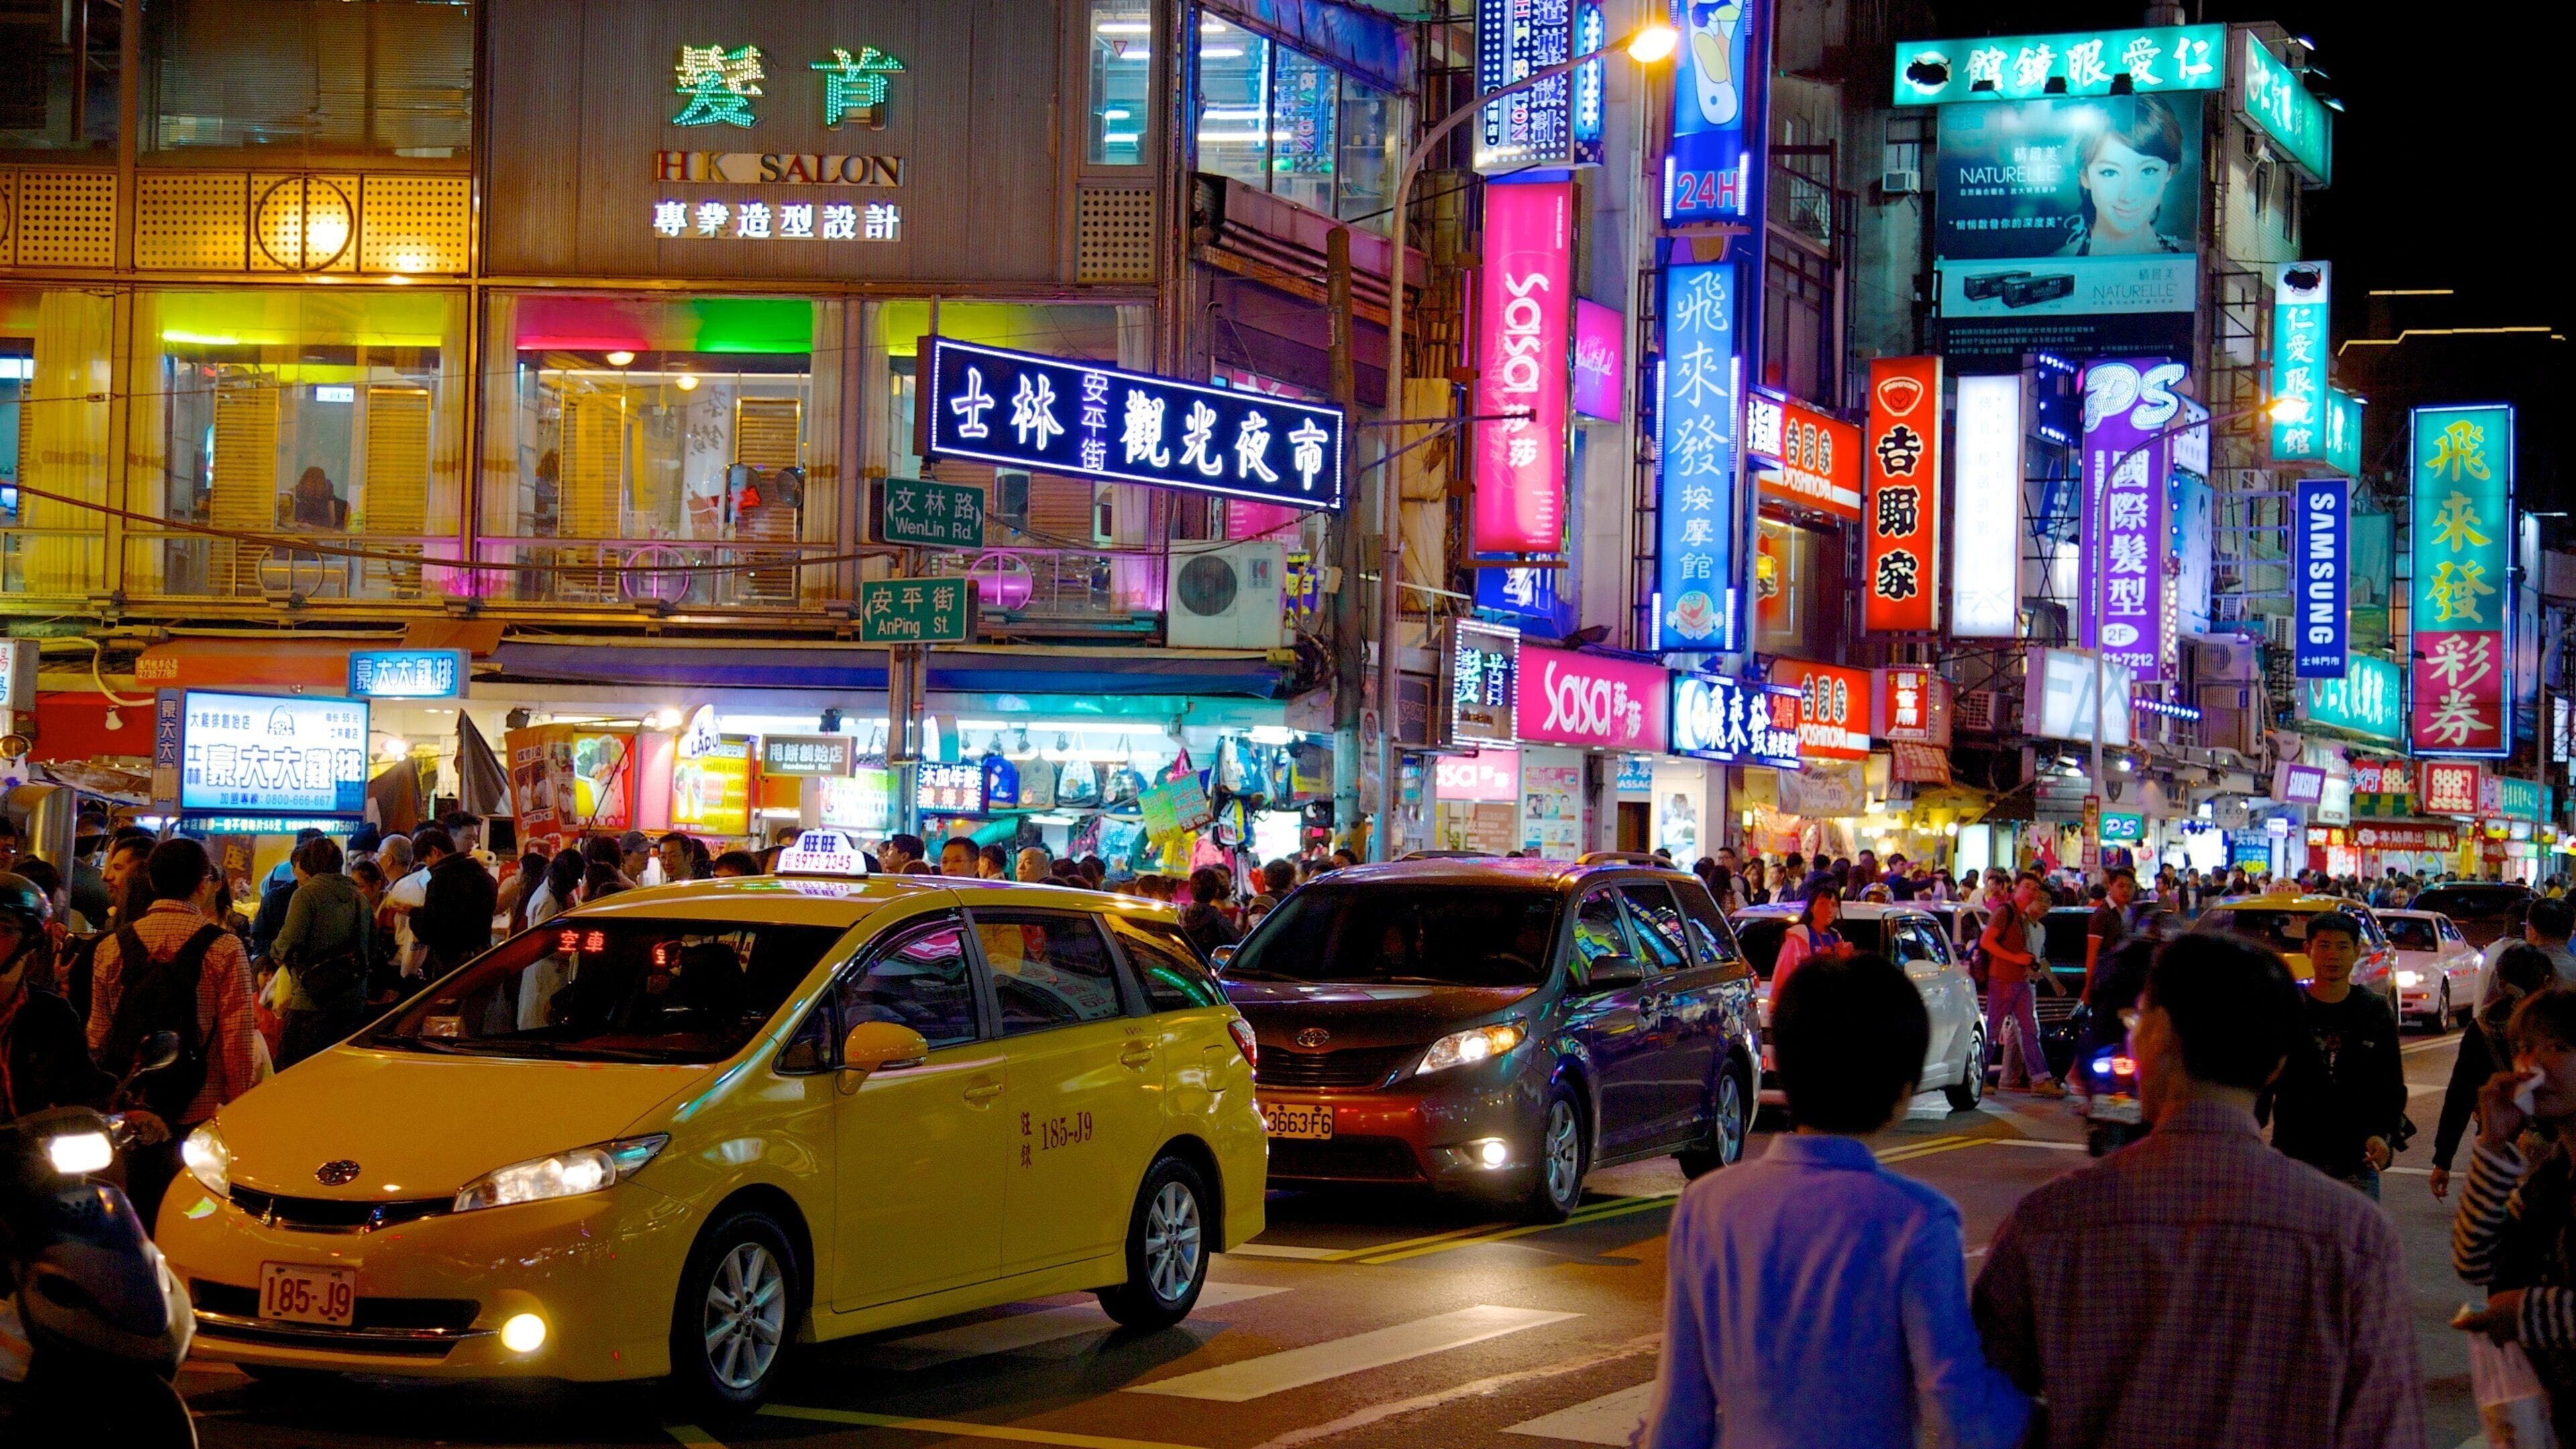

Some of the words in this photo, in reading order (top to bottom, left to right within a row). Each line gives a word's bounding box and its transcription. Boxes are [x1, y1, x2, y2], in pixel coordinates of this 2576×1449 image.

[760, 153, 900, 186] SALON
[1960, 166, 2056, 184] NATURELLE
[1677, 172, 1739, 210] 24H
[653, 201, 901, 239] 專業造型設計
[2094, 284, 2174, 299] NATURELLE
[951, 367, 1064, 451] 士林
[2085, 363, 2187, 433] PS
[1080, 371, 1109, 471] 安平街
[1121, 388, 1328, 491] 觀光夜市
[1784, 467, 1832, 501] YOSHINOYA
[896, 488, 975, 520] 文林路
[896, 517, 945, 537] WenLin
[952, 521, 973, 540] Rd.
[2108, 449, 2149, 616] 國際髮型
[2308, 492, 2336, 644] SAMSUNG
[872, 586, 953, 614] 安平街
[877, 617, 920, 639] AnPing
[2108, 629, 2128, 641] 2F
[356, 657, 455, 692] 豪大大雞排
[2302, 656, 2340, 665] 士林門市
[2422, 634, 2494, 746] 彩券
[191, 712, 250, 730] 大雞排創始店
[1613, 681, 1642, 738] 莎莎
[159, 698, 177, 801] 豪大大
[691, 734, 719, 755] LADU
[769, 743, 843, 763] 甩餅創始店
[186, 744, 201, 785] 士林
[207, 744, 363, 790] 豪大大雞排
[782, 763, 815, 771] Handmade
[818, 762, 831, 771] Roll
[2288, 770, 2321, 799] SAMSUNG
[804, 835, 837, 852] 旺旺
[2105, 818, 2137, 837] PS
[795, 853, 852, 870] 8973-2345
[558, 930, 604, 952] 空車
[1041, 1112, 1093, 1150] 185-J9
[267, 1276, 352, 1318] 185-J9
